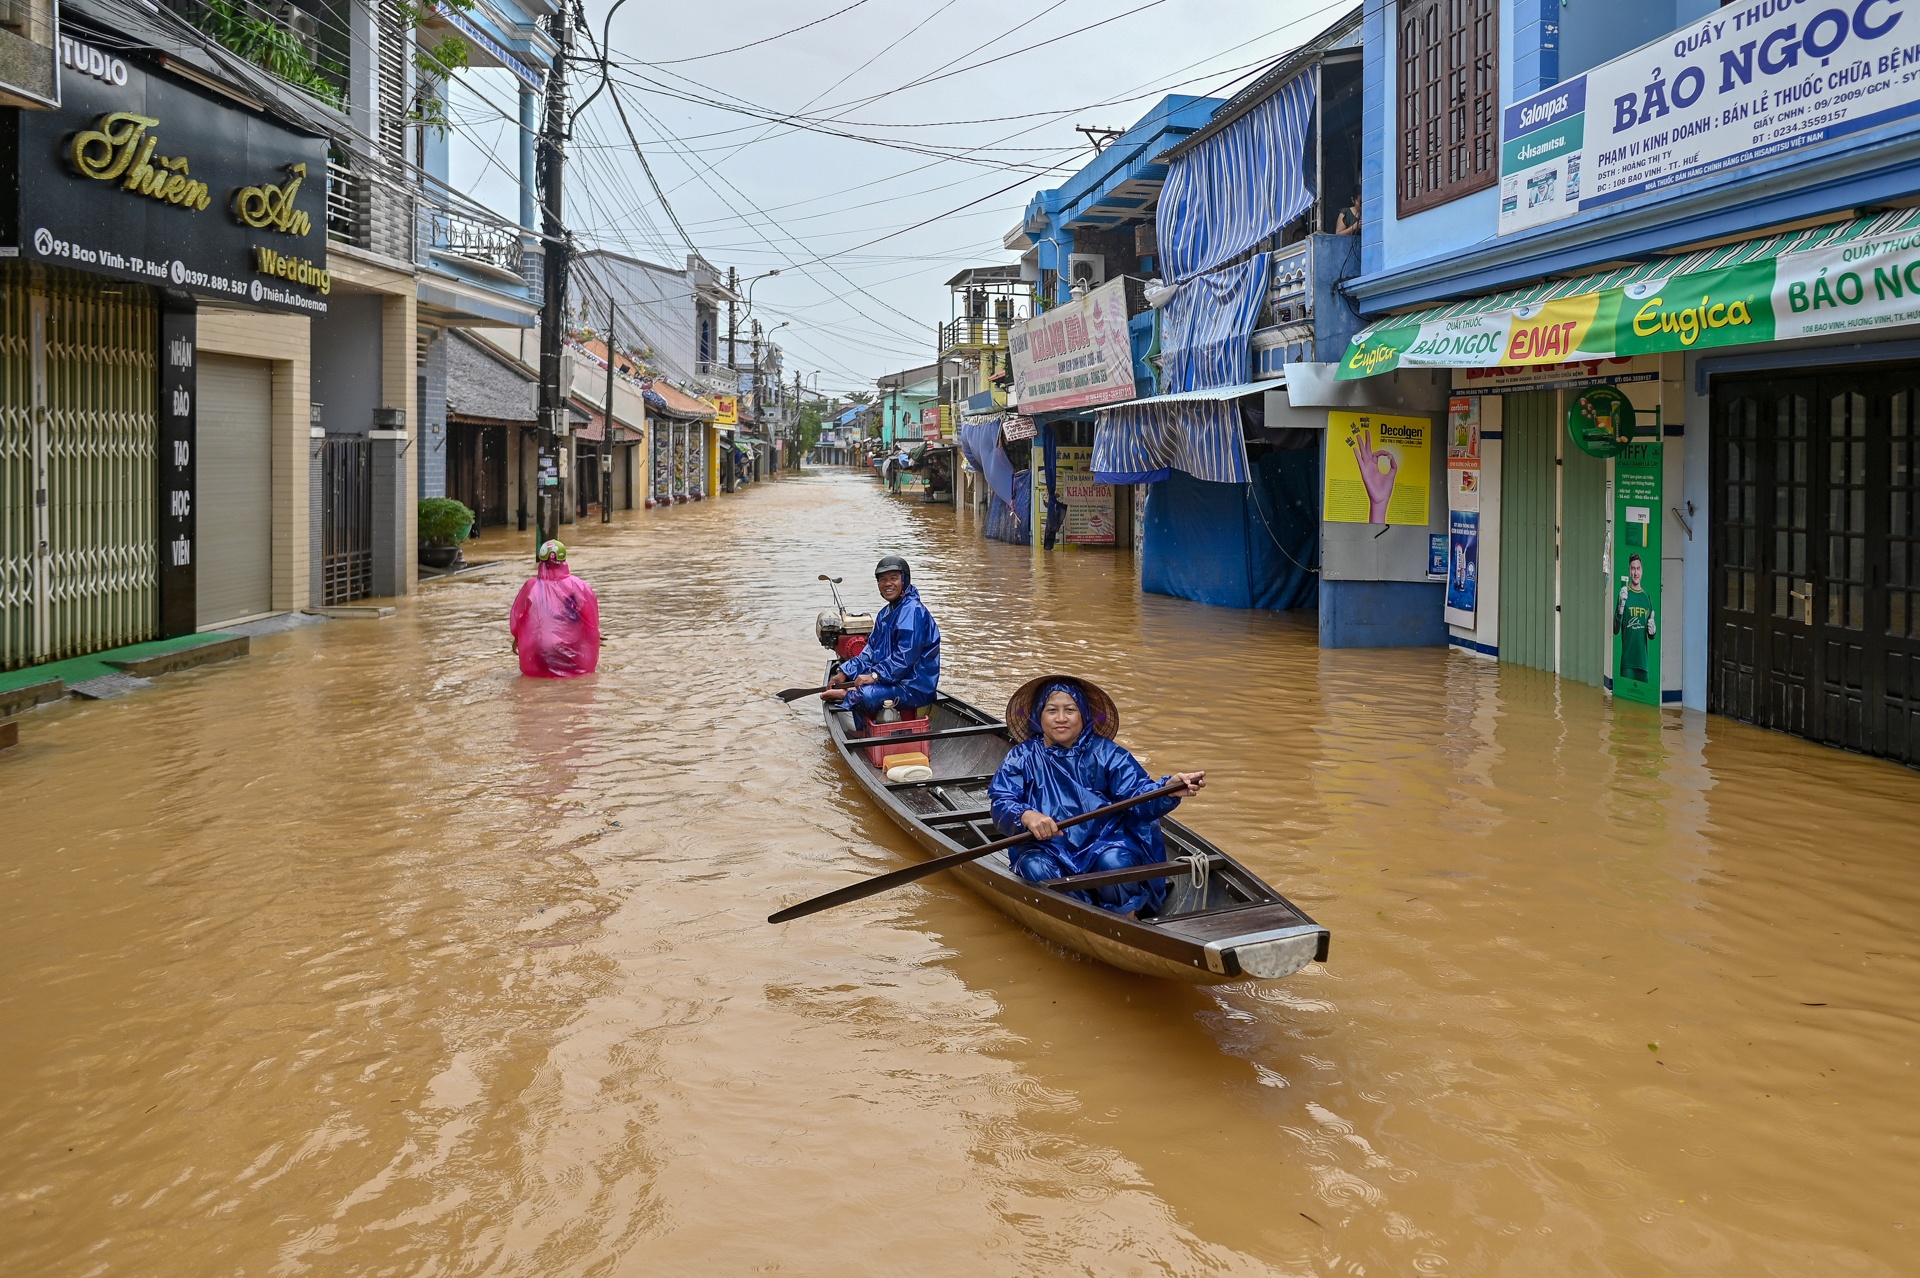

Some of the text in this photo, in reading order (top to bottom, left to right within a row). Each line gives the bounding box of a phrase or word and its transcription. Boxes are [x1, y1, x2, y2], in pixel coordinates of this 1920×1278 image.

[1674, 21, 1726, 58] QUẦY
[59, 36, 128, 86] TUDIO
[1612, 0, 1904, 134] BẢO NGỌC
[1519, 93, 1568, 129] Salonpas
[1598, 145, 1627, 168] PHẠM
[1630, 142, 1640, 157] VI
[1643, 131, 1668, 153] KINH
[1672, 116, 1711, 142] DOANH
[1722, 102, 1748, 126] BÁN
[1752, 90, 1769, 115] LẺ
[1774, 73, 1823, 107] THUỐC
[1828, 60, 1872, 90] CHỮA
[1752, 108, 1848, 144] ĐT 0234.3559157
[1753, 114, 1775, 130] GIẤY
[1777, 106, 1804, 123] CNHN
[1517, 136, 1565, 160] Hisamitsu
[1598, 150, 1672, 180] DSTH HOÀNG THỊ TY
[1645, 182, 1656, 191] NHÀ
[1657, 176, 1675, 189] THUỐC
[1675, 171, 1688, 182] BÁN
[1687, 167, 1704, 178] HÀNG
[1703, 160, 1722, 174] CHÍNH
[1740, 150, 1754, 162] CỦA
[1754, 142, 1790, 157] HISAMITSU
[1790, 136, 1806, 148] VIỆT
[1806, 131, 1824, 143] NAM
[71, 111, 311, 237] Thiên Ân
[1613, 177, 1626, 188] 108
[1628, 173, 1642, 184] BAO
[1644, 166, 1661, 179] VINH
[1683, 151, 1700, 166] HUẾ
[54, 240, 70, 257] 93
[72, 244, 97, 263] Bao
[185, 269, 247, 295] 0397.889.587
[258, 247, 331, 295] Wedding
[263, 287, 328, 313] Thiên Ân Doremon
[1789, 267, 1864, 313] BẢO
[1632, 295, 1752, 346] Eugica
[1802, 323, 1814, 333] 108
[1814, 321, 1828, 332] BAO
[1847, 316, 1873, 327] HƯƠNG
[1349, 343, 1398, 374] Eugica
[1411, 331, 1502, 359] BẢO NGỌC
[1508, 321, 1577, 360] ENAT
[1380, 423, 1423, 439] Decolgen
[171, 335, 192, 566] NHẬN ĐÀO TẠO HỌC VIÊN
[1067, 484, 1094, 497] KHÁNH
